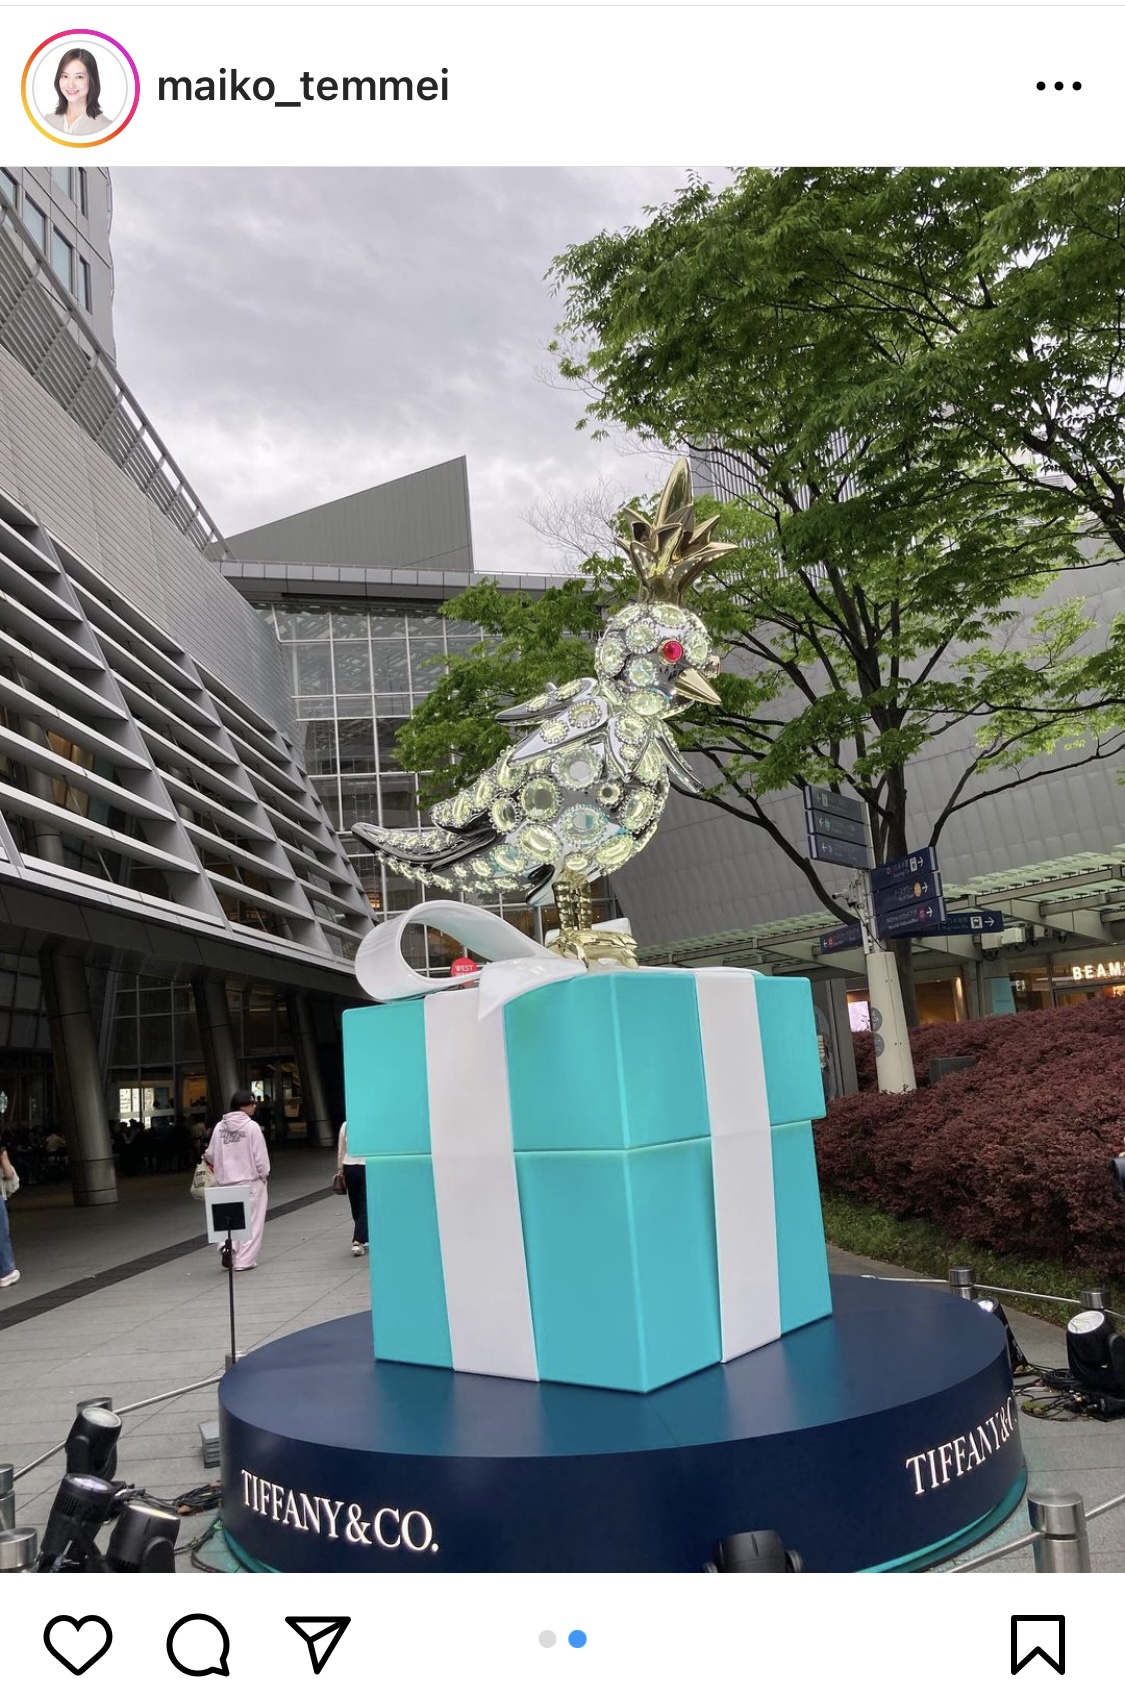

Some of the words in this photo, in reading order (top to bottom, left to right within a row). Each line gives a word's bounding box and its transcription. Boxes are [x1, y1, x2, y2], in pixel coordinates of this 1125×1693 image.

[454, 964, 474, 972] WEST
[1072, 960, 1125, 981] BEAM
[241, 1469, 439, 1553] TIFFANY&CO.
